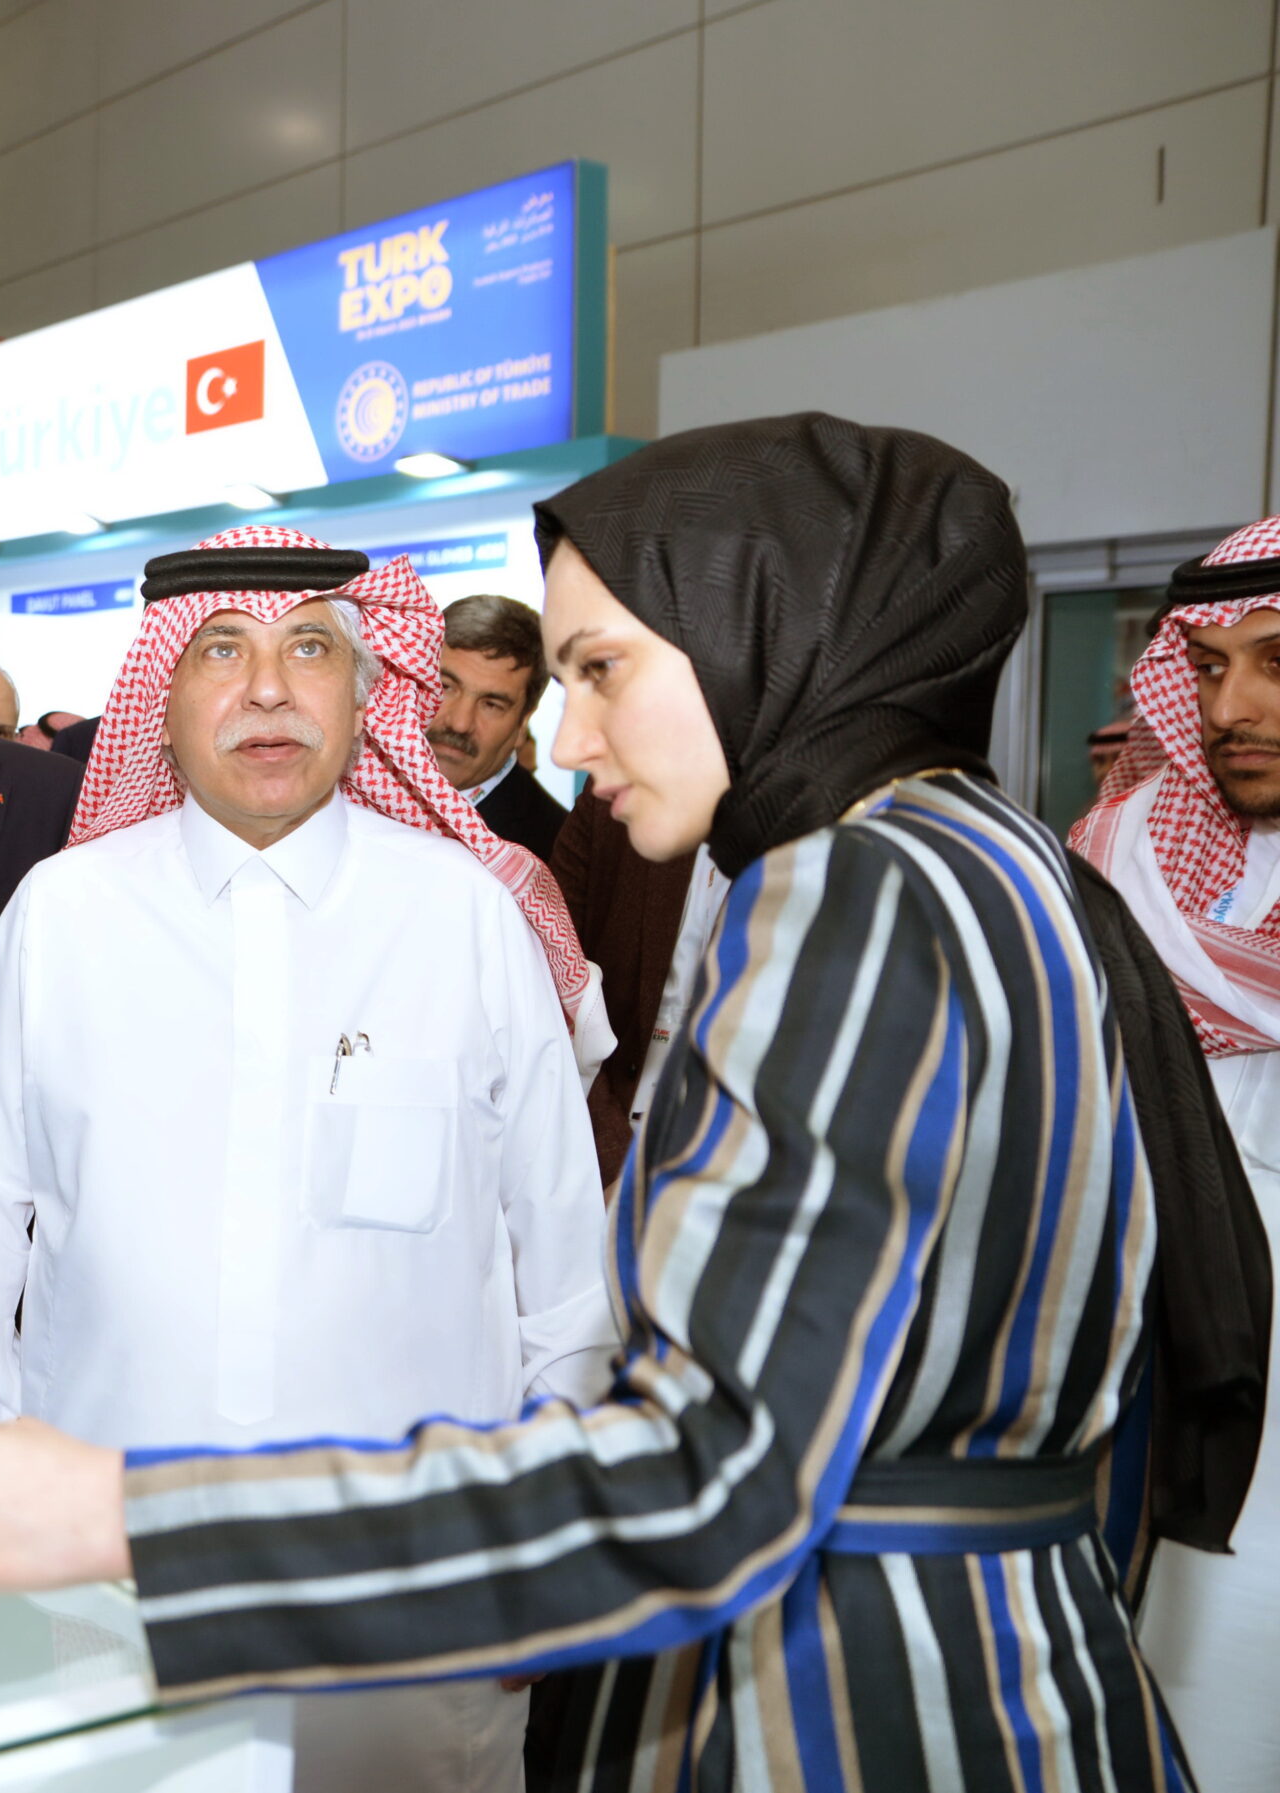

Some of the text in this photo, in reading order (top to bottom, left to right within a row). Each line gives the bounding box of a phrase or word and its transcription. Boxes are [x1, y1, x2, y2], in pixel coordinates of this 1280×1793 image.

[339, 218, 449, 290] TURK
[339, 264, 453, 332] EXPO
[480, 388, 500, 408] OF
[503, 376, 552, 402] TRADE
